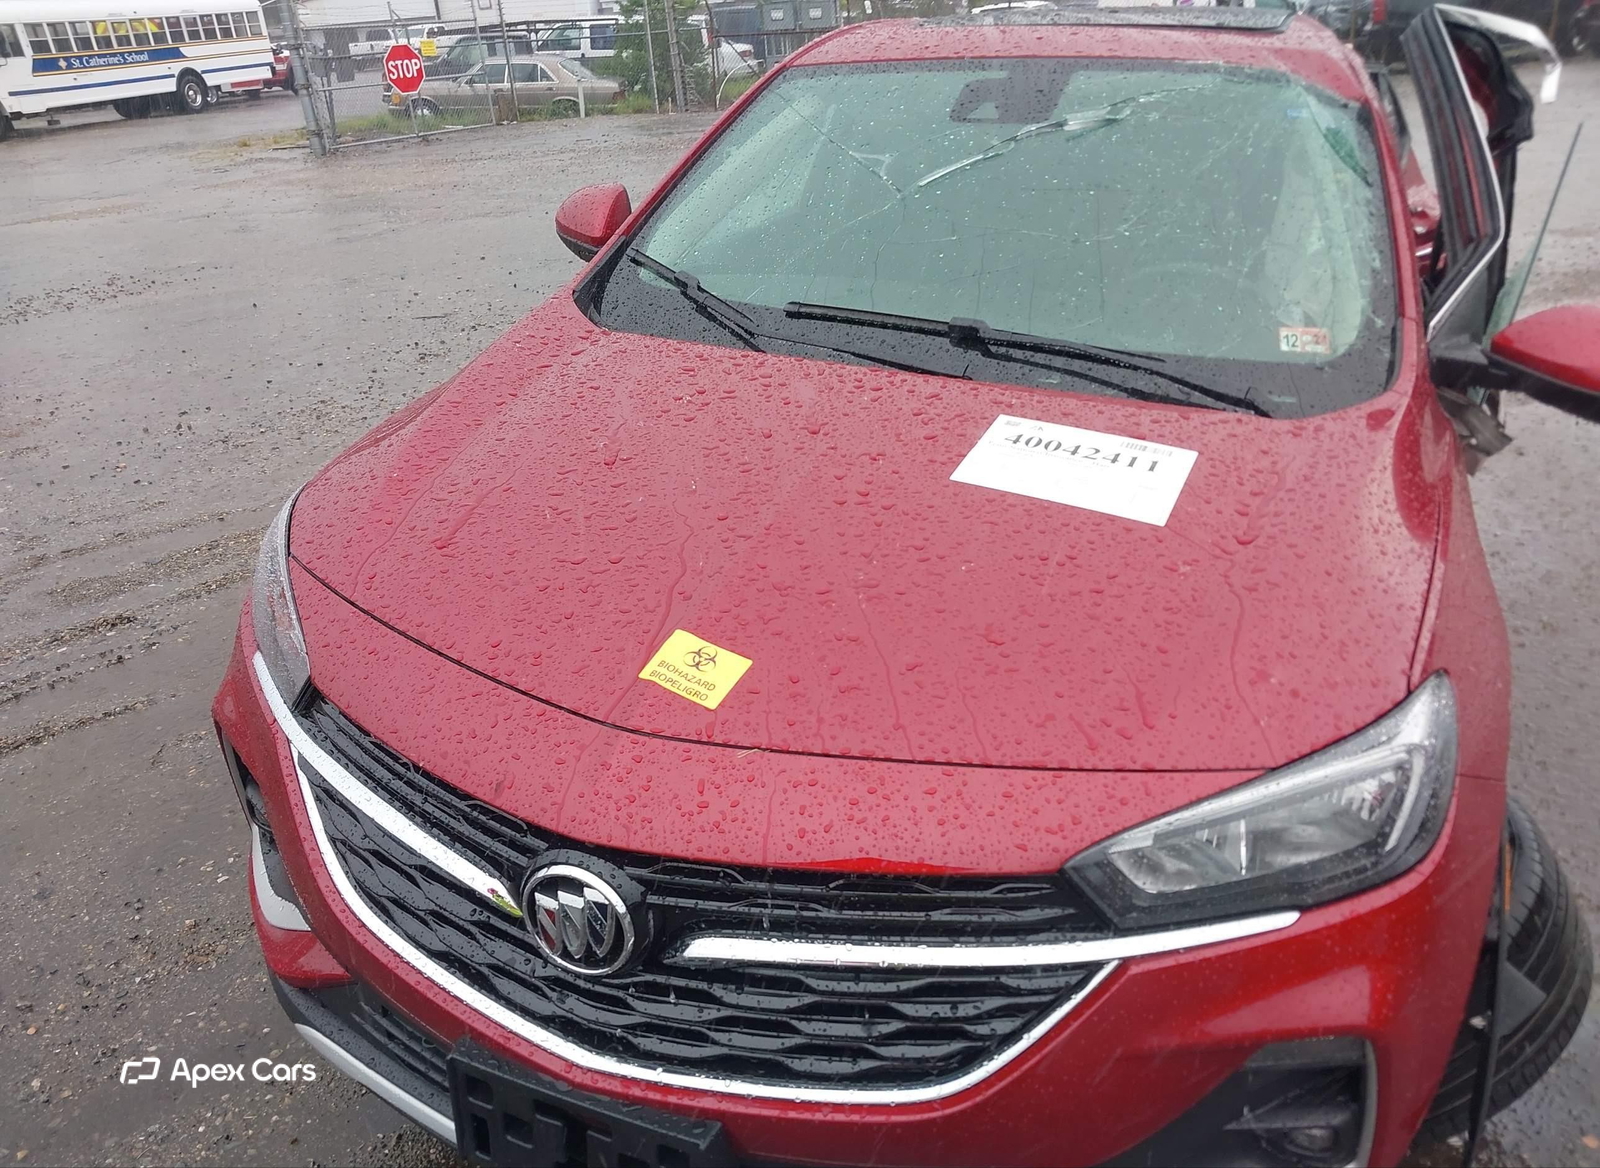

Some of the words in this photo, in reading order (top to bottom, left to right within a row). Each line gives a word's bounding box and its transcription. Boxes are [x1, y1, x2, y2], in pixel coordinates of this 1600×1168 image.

[71, 58, 84, 68] St.
[83, 55, 124, 67] Catherine's
[124, 52, 149, 63] School
[388, 59, 420, 79] STOP
[1283, 334, 1299, 348] 12
[1004, 433, 1159, 472] 40042411
[649, 670, 709, 702] BIOPELIGRO
[657, 660, 716, 692] BIOHAZARD
